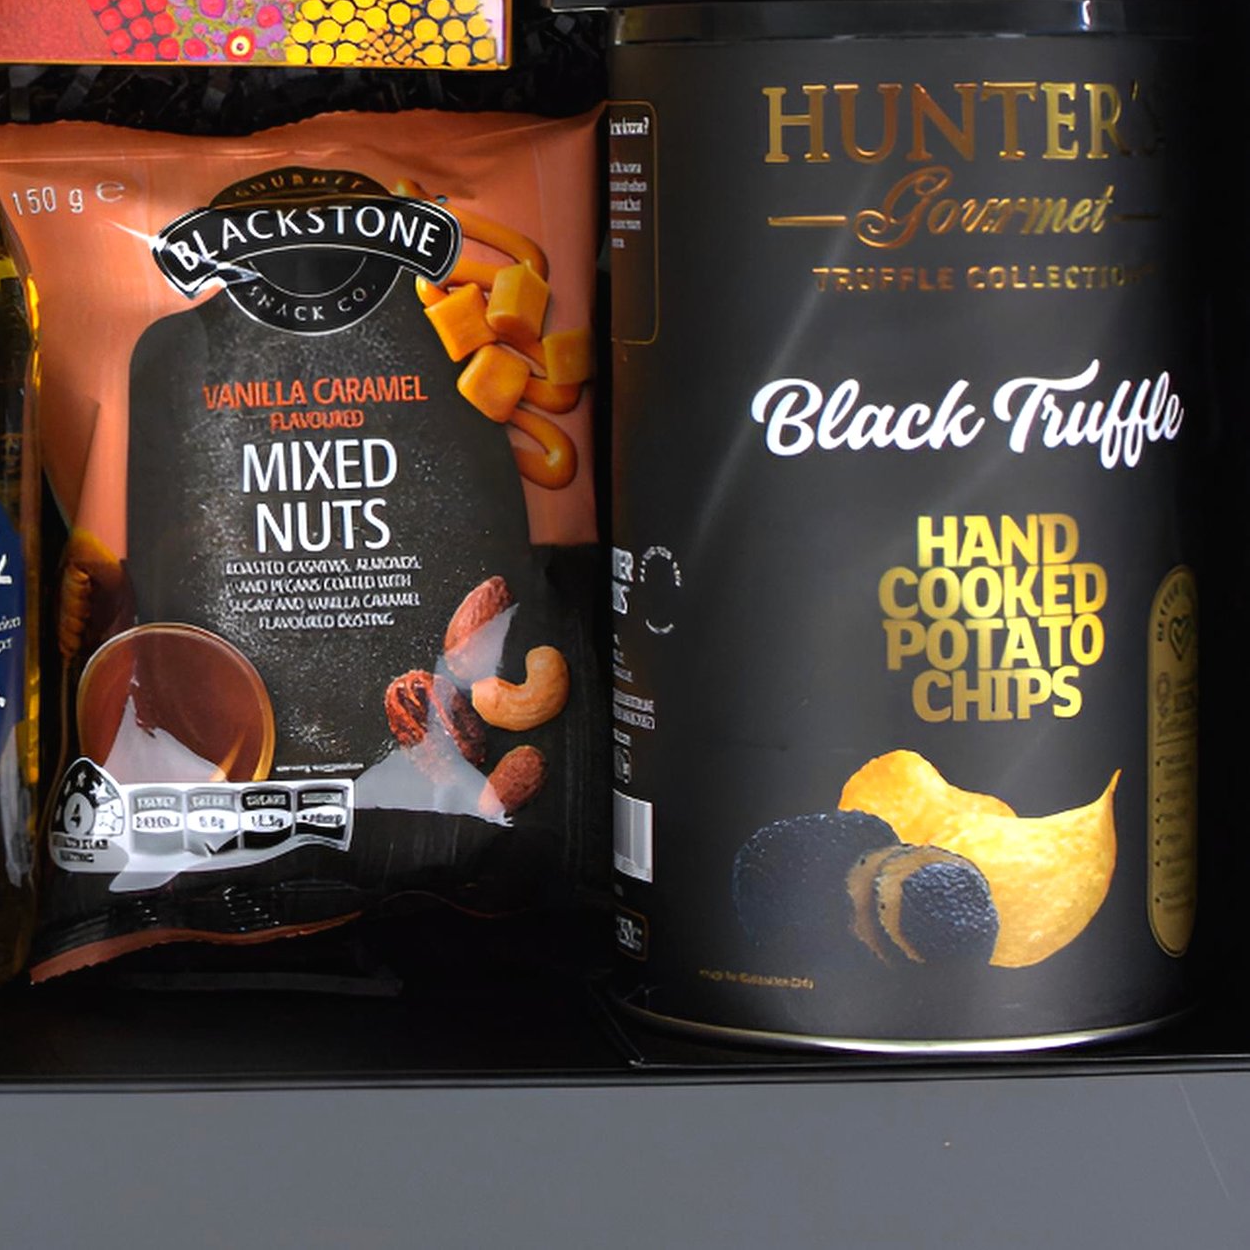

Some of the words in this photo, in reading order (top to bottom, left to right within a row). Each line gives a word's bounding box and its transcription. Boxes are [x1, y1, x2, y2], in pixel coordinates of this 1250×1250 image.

[762, 80, 1162, 164] HUNTER'
[11, 185, 56, 216] 150
[70, 188, 85, 214] g
[853, 166, 1115, 249] Gourmet
[168, 205, 441, 272] BLACKSTONE
[812, 267, 955, 291] TRUFFLE
[967, 265, 1145, 290] COLLECTIO
[202, 380, 307, 410] VANILLA
[312, 375, 428, 405] CARAMEL
[750, 378, 986, 456] Black
[992, 358, 1185, 469] Truffle
[270, 409, 365, 432] FLAVOURED
[242, 438, 398, 493] MIXED
[256, 498, 391, 553] NUTS
[917, 513, 1079, 568] HAND
[878, 563, 1108, 620] COOKED
[882, 613, 1105, 670] POTATO
[913, 666, 1082, 722] CHIPS
